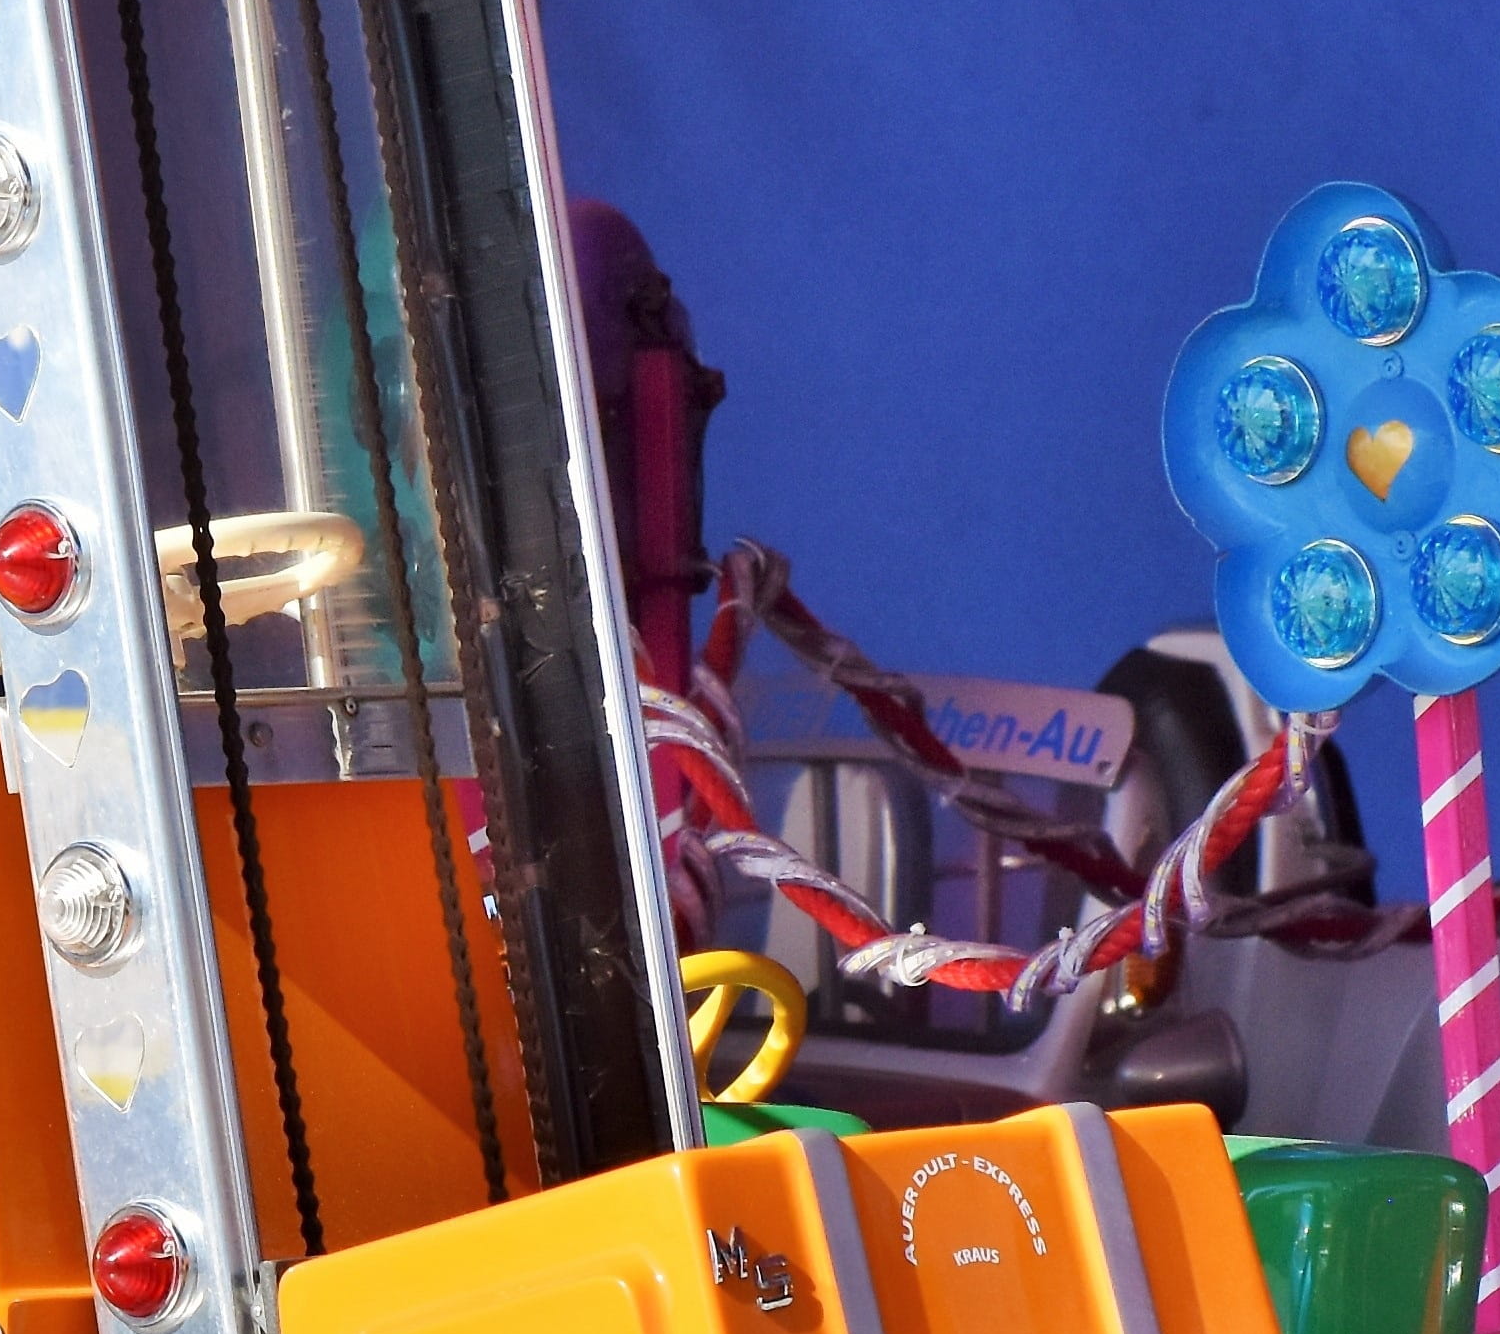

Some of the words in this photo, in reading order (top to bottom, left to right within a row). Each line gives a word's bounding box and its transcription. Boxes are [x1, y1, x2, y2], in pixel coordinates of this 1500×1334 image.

[927, 697, 1103, 766] hen-Au
[902, 1186, 920, 1267] AUER
[912, 1152, 958, 1189] DULT
[973, 1155, 1048, 1257] EXPRESS
[952, 1246, 1000, 1267] KRAUS
